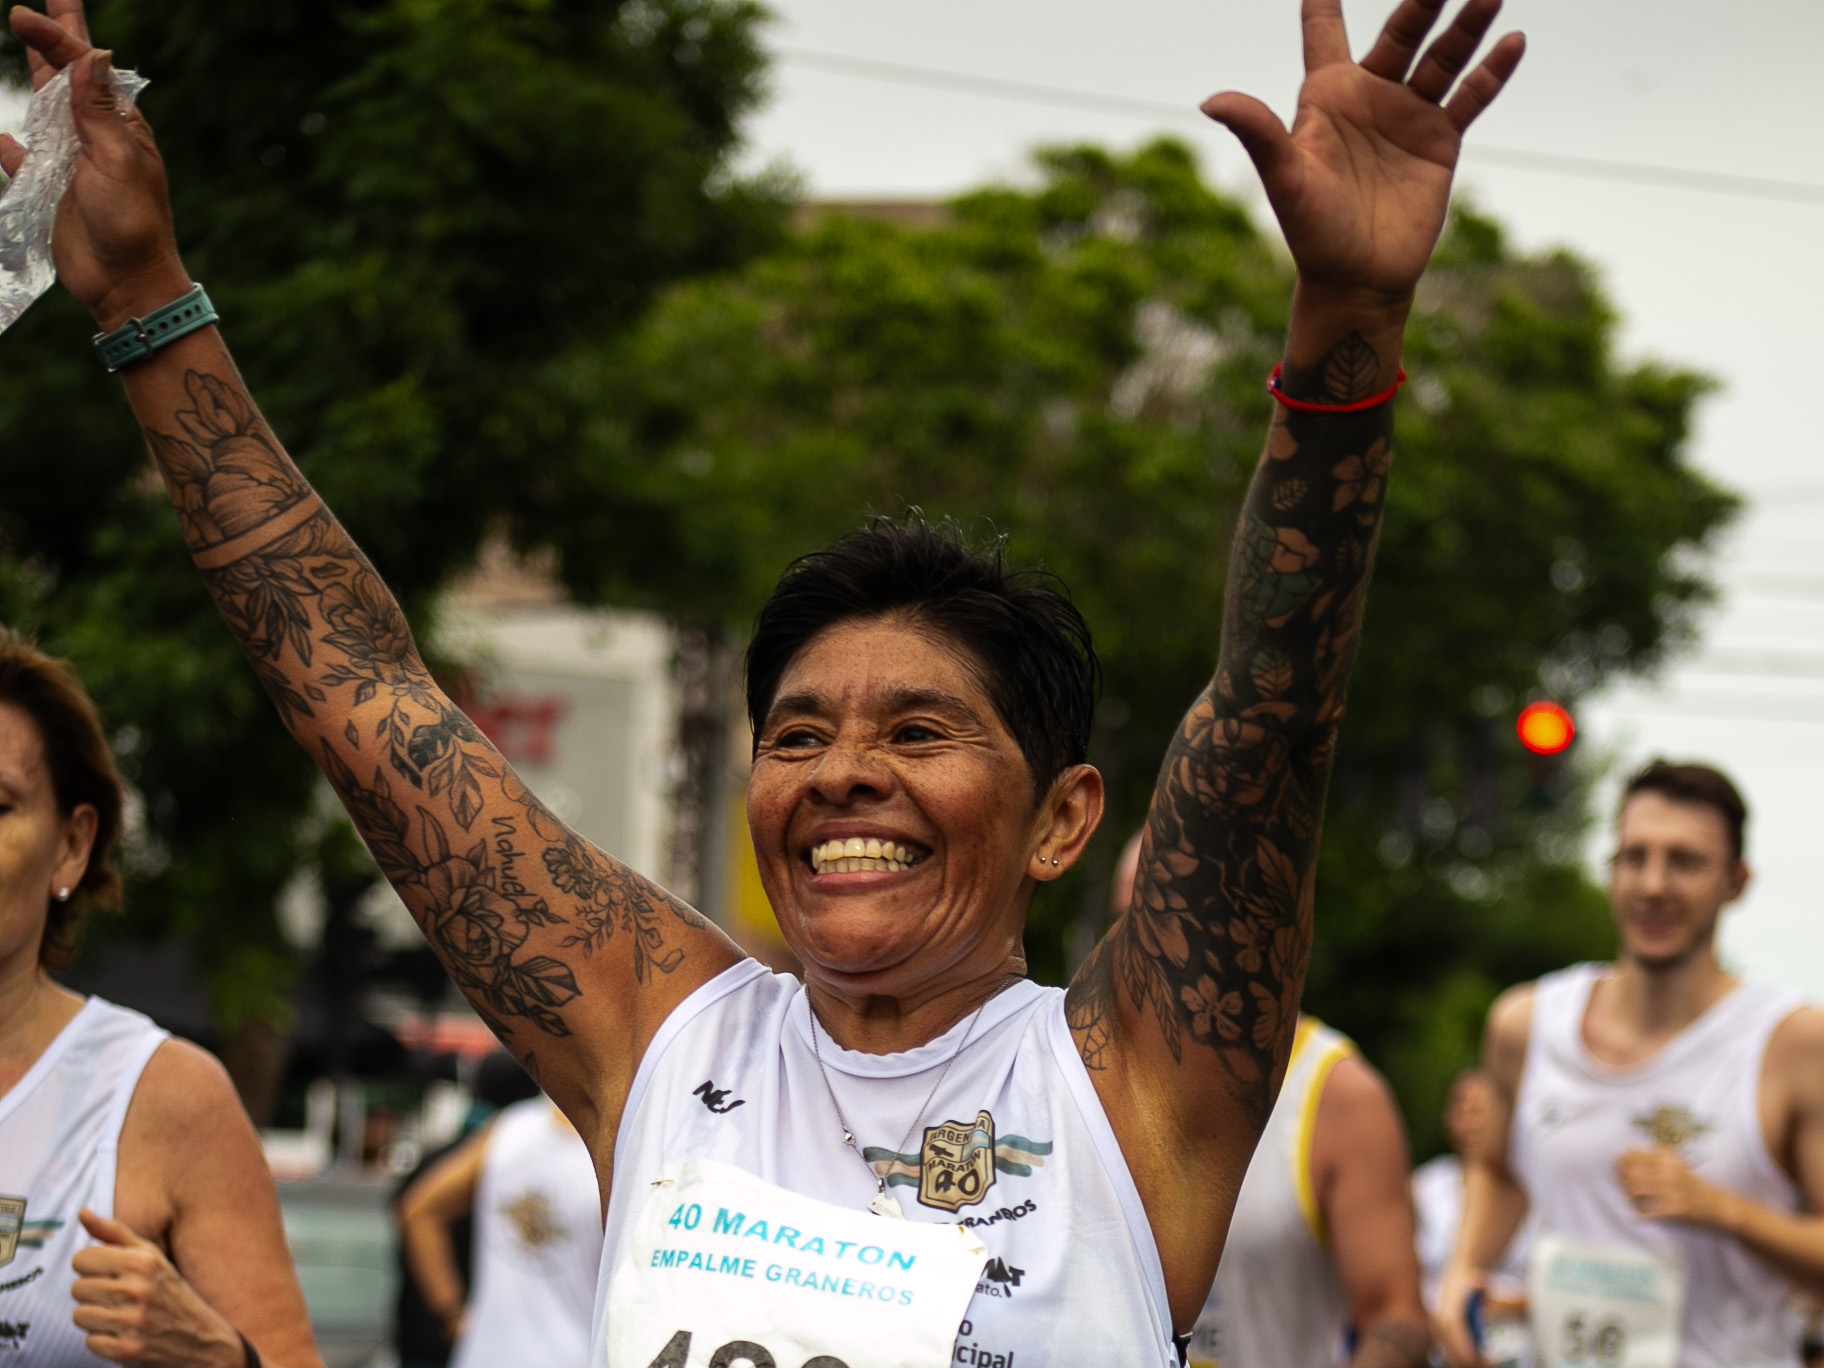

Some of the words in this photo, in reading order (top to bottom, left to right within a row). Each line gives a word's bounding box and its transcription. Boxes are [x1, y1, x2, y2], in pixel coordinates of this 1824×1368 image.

[935, 1169, 980, 1196] 40
[668, 1203, 702, 1230] 40
[713, 1207, 917, 1272] MARATON
[650, 1249, 757, 1279] EMPALME
[765, 1263, 914, 1306] GRANEROS
